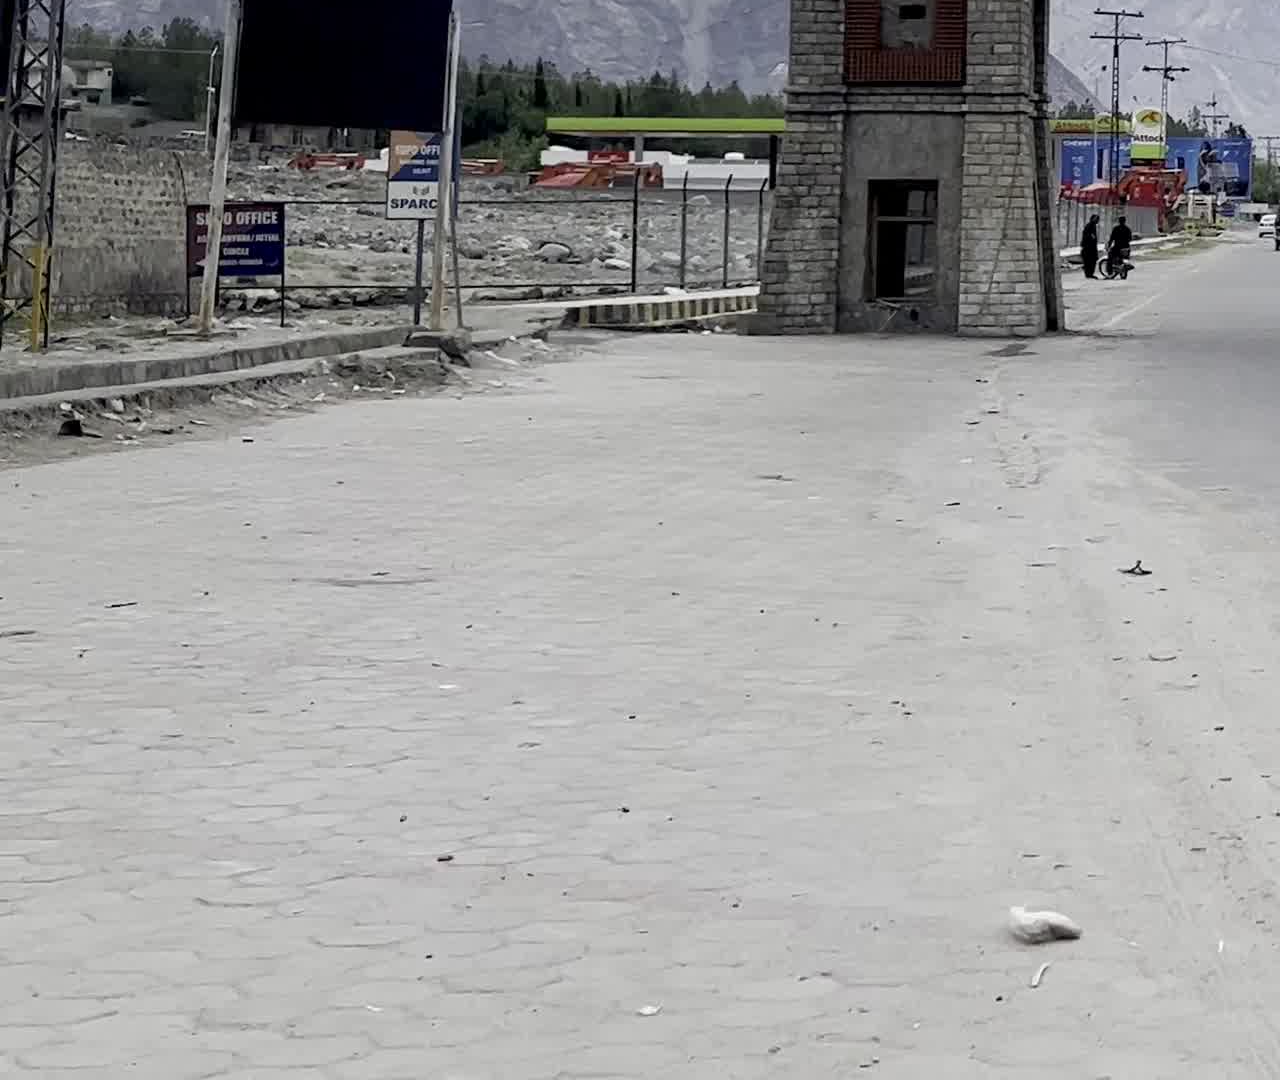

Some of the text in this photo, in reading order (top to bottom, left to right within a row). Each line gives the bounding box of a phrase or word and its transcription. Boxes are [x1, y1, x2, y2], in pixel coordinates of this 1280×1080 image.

[1134, 133, 1164, 142] Attock
[390, 198, 438, 209] SPARC
[196, 211, 278, 225] SO OFFICE
